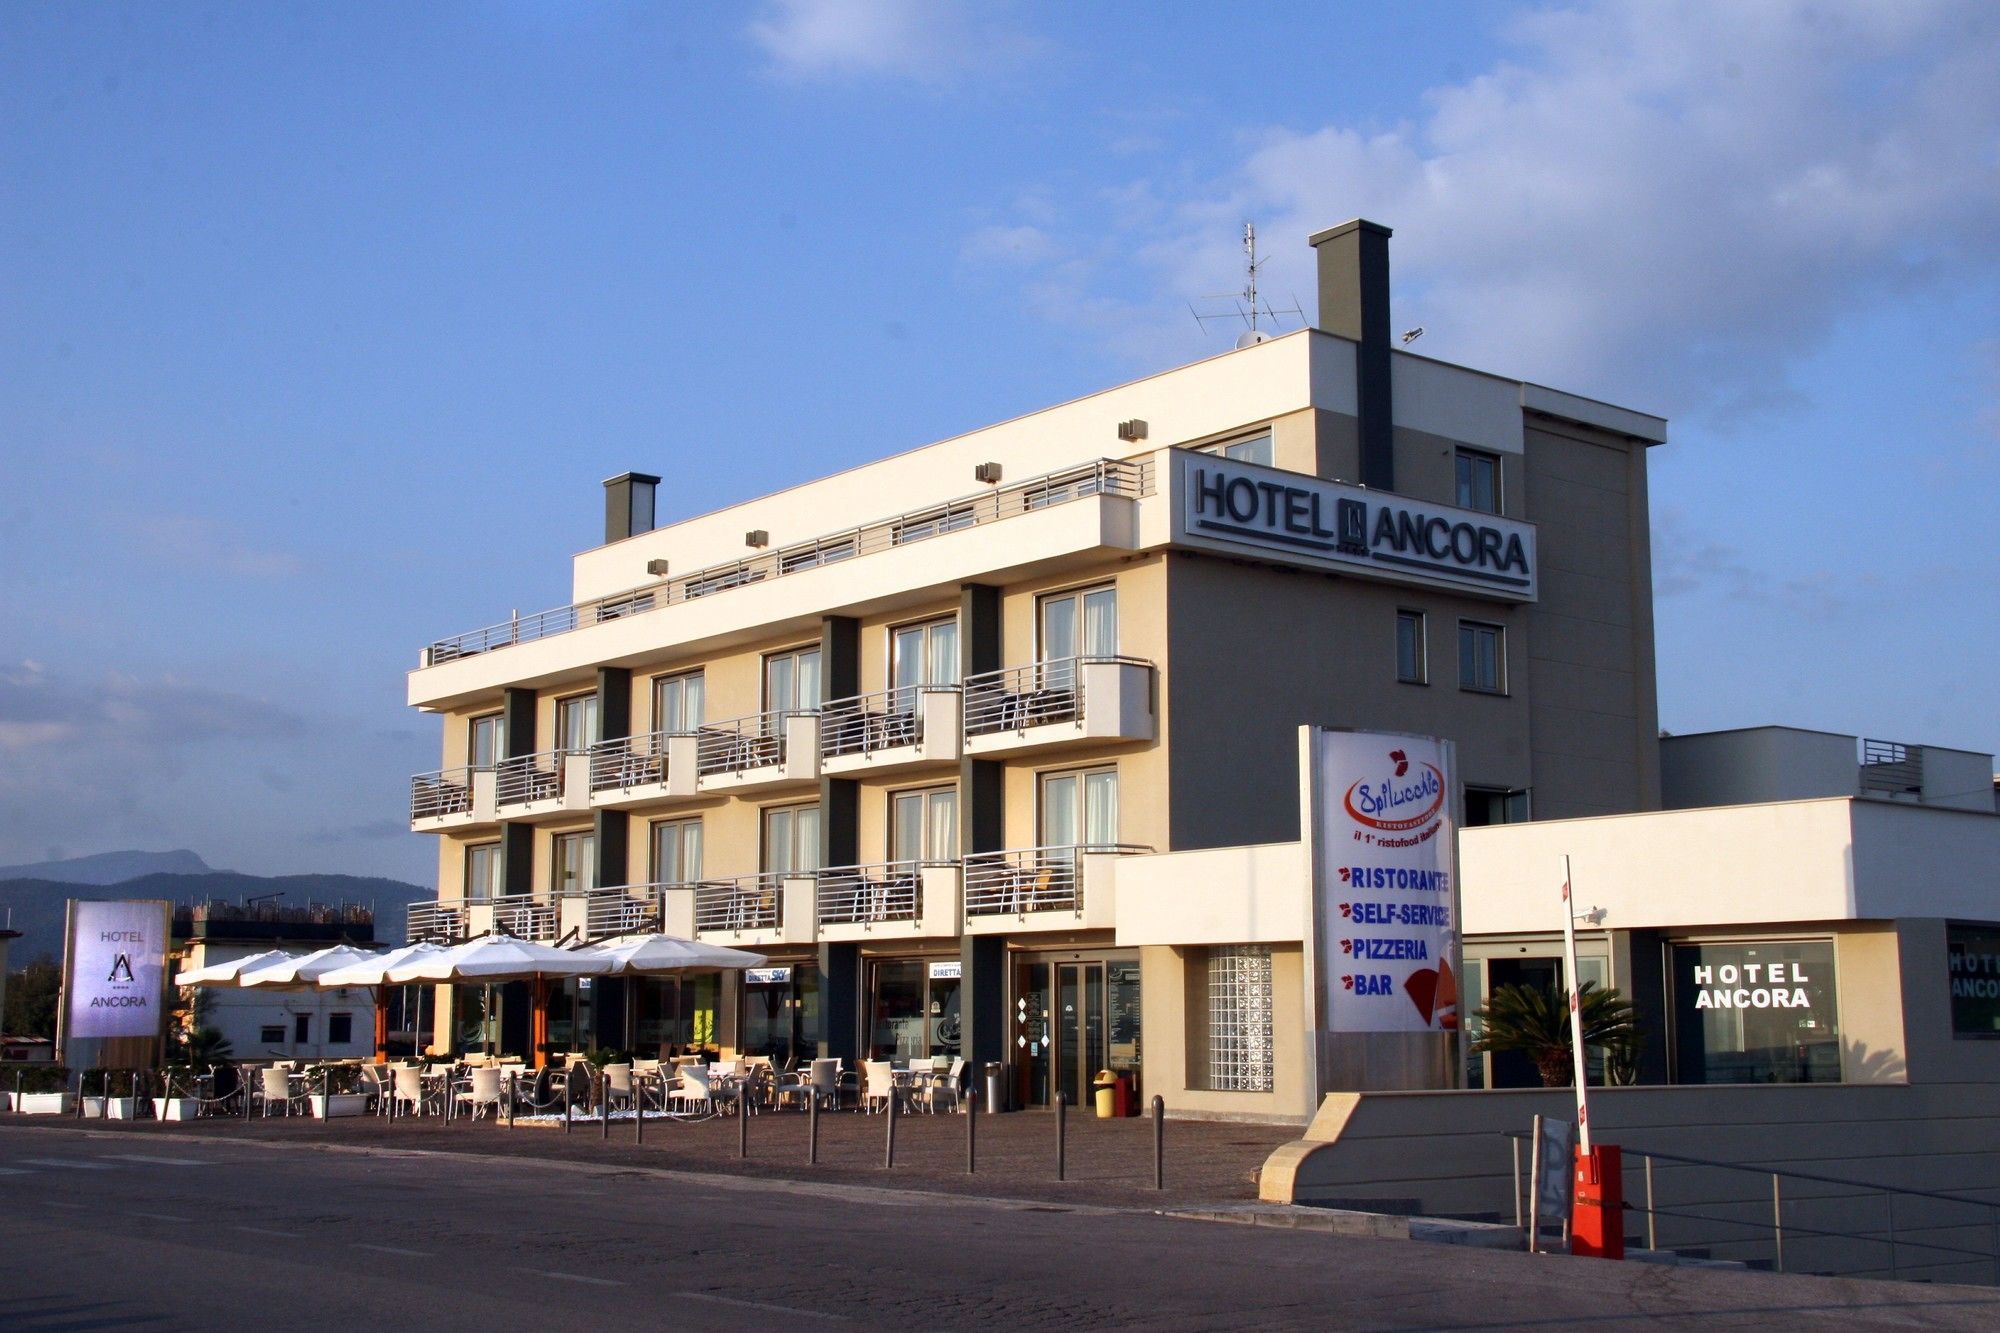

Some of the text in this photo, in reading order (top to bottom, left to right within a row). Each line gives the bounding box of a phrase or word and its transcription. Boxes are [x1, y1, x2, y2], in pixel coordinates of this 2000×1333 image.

[1196, 468, 1530, 574] HOTEL ANCORA
[1354, 830, 1361, 841] il
[1377, 835, 1419, 848] ristofood
[1351, 867, 1450, 892] RISTORANTE
[1352, 902, 1450, 926] SELF-SERVICE
[101, 931, 144, 942] HOTEL
[1353, 938, 1428, 960] PIZZERIA
[1354, 974, 1393, 996] BAR
[1694, 963, 1809, 985] HOTEL
[90, 996, 147, 1008] ANCORA
[1694, 988, 1811, 1009] ANCORA
